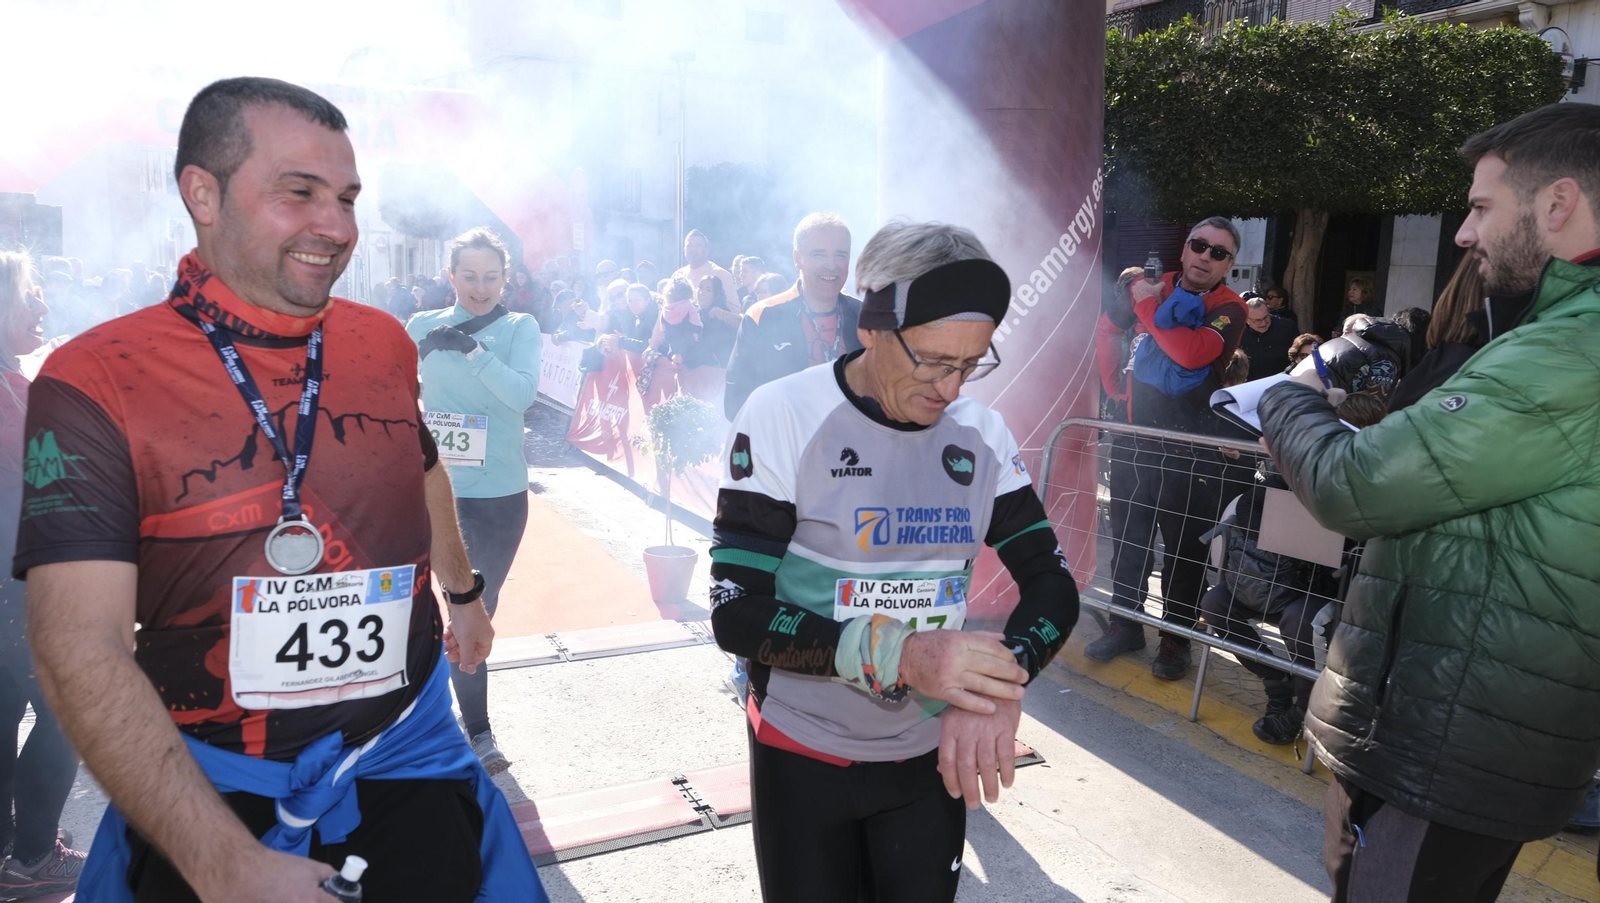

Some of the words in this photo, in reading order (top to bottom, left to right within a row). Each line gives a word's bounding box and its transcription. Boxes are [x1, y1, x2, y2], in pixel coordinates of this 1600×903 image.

[991, 167, 1104, 343] w.teamergy.es
[193, 291, 282, 339] PÓLVO
[271, 373, 330, 386] TEAMY
[830, 467, 873, 478] VIATOR
[207, 503, 263, 532] CxM
[896, 507, 942, 523] TRANS
[945, 507, 971, 523] FRIO
[896, 525, 975, 545] HIGUERAL
[267, 580, 287, 595] IV
[294, 577, 332, 594] CxM
[859, 581, 876, 593] IV
[880, 582, 914, 594] CxM
[258, 600, 280, 613] LA
[287, 594, 362, 614] PÓLVORA
[853, 597, 870, 608] LA
[875, 597, 932, 609] PÓLVORA
[768, 606, 807, 636] Trail
[275, 614, 385, 672] 433
[281, 677, 323, 687] FERNANDEZ
